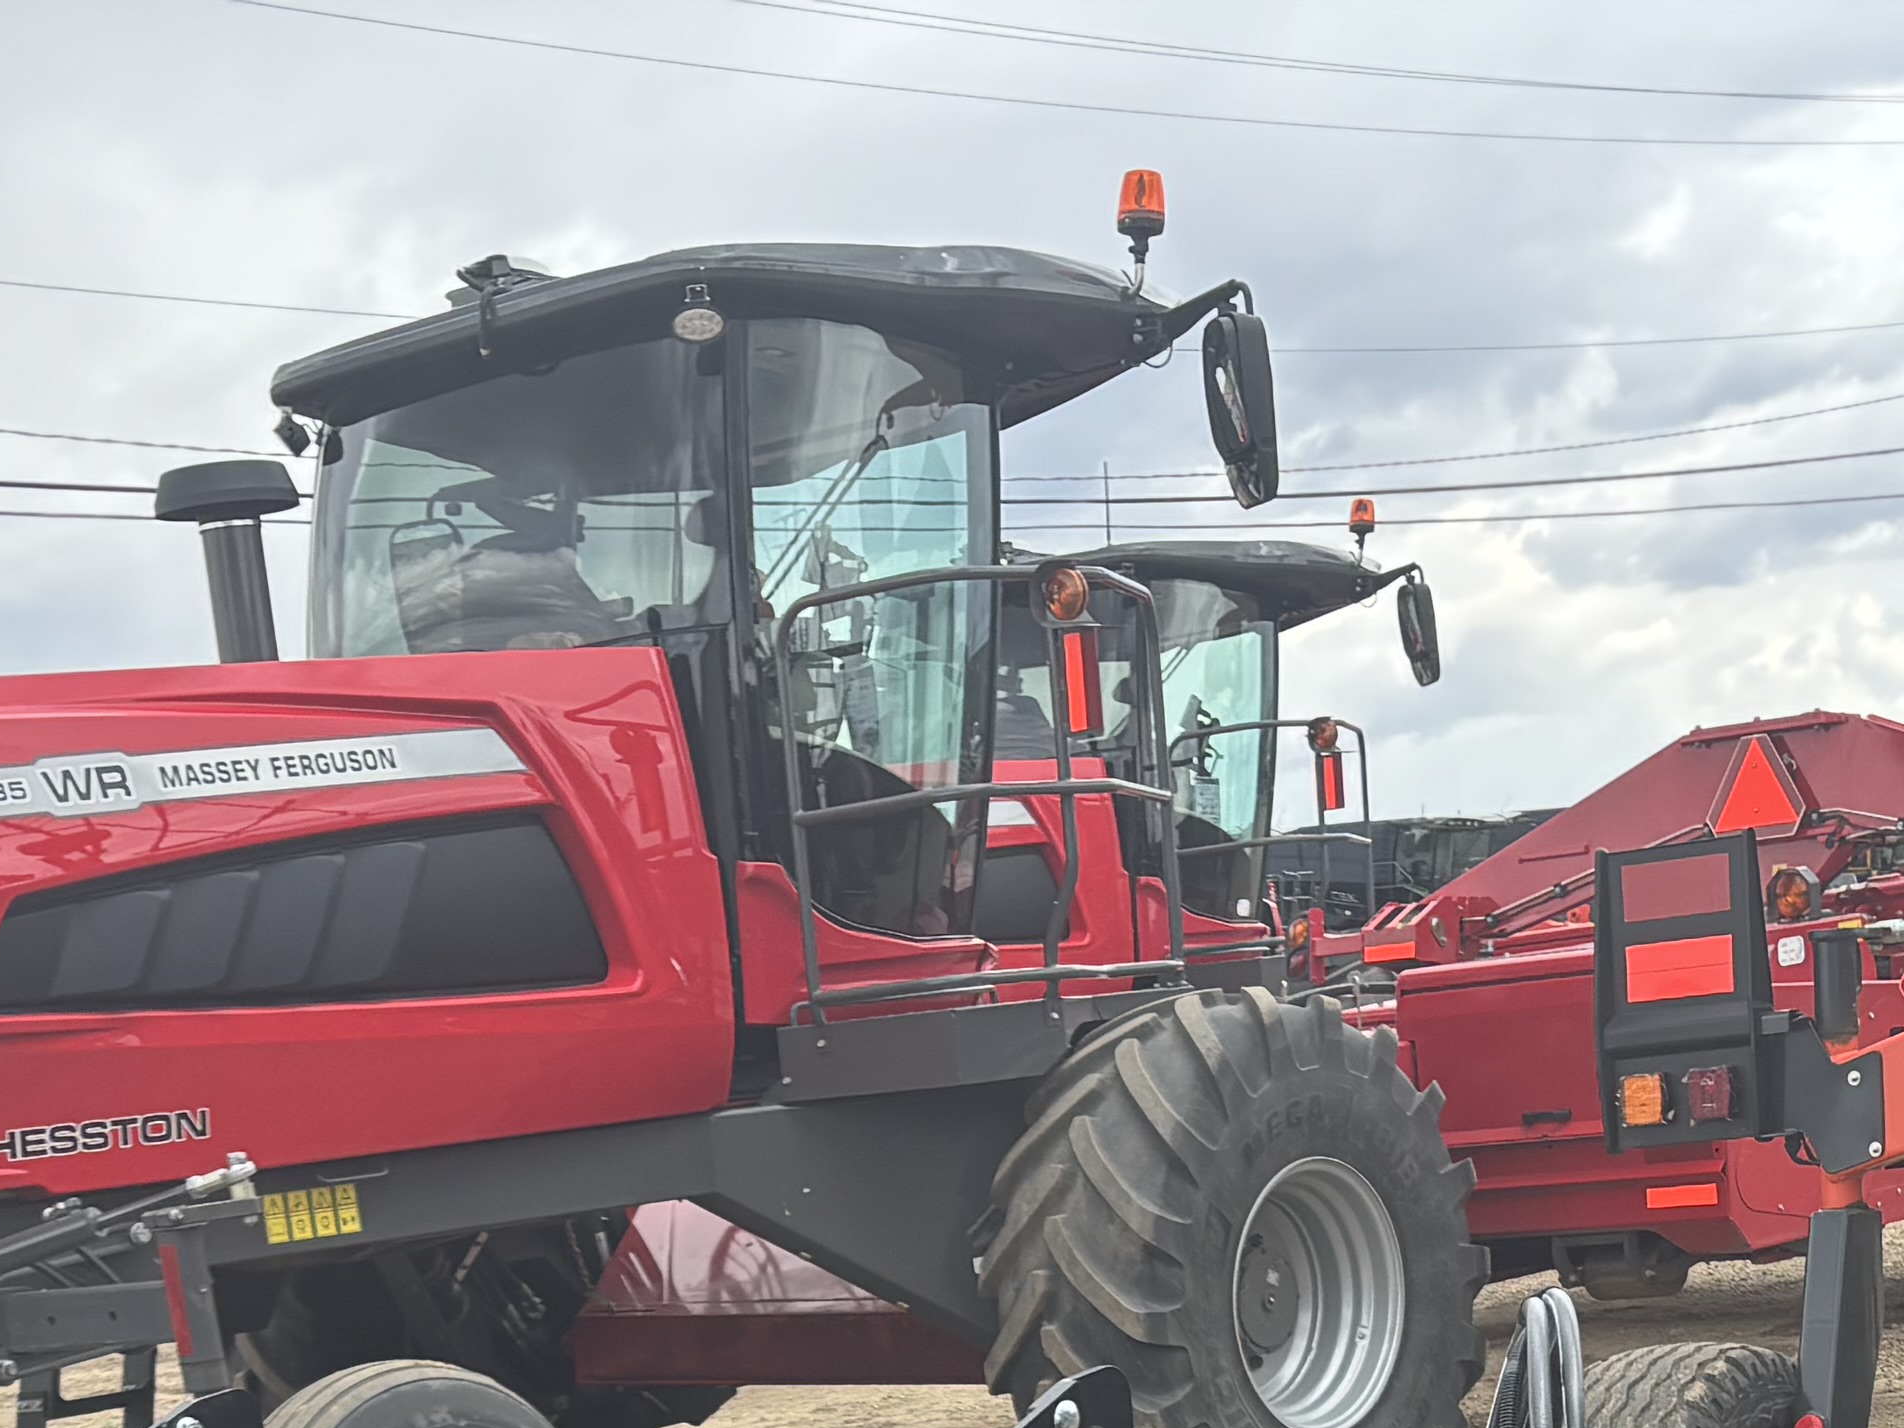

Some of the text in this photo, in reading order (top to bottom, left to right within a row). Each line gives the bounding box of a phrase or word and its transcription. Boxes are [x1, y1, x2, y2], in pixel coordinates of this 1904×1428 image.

[40, 764, 132, 803] WR
[159, 758, 260, 789] MASSEY
[271, 748, 396, 778] FERGUSON
